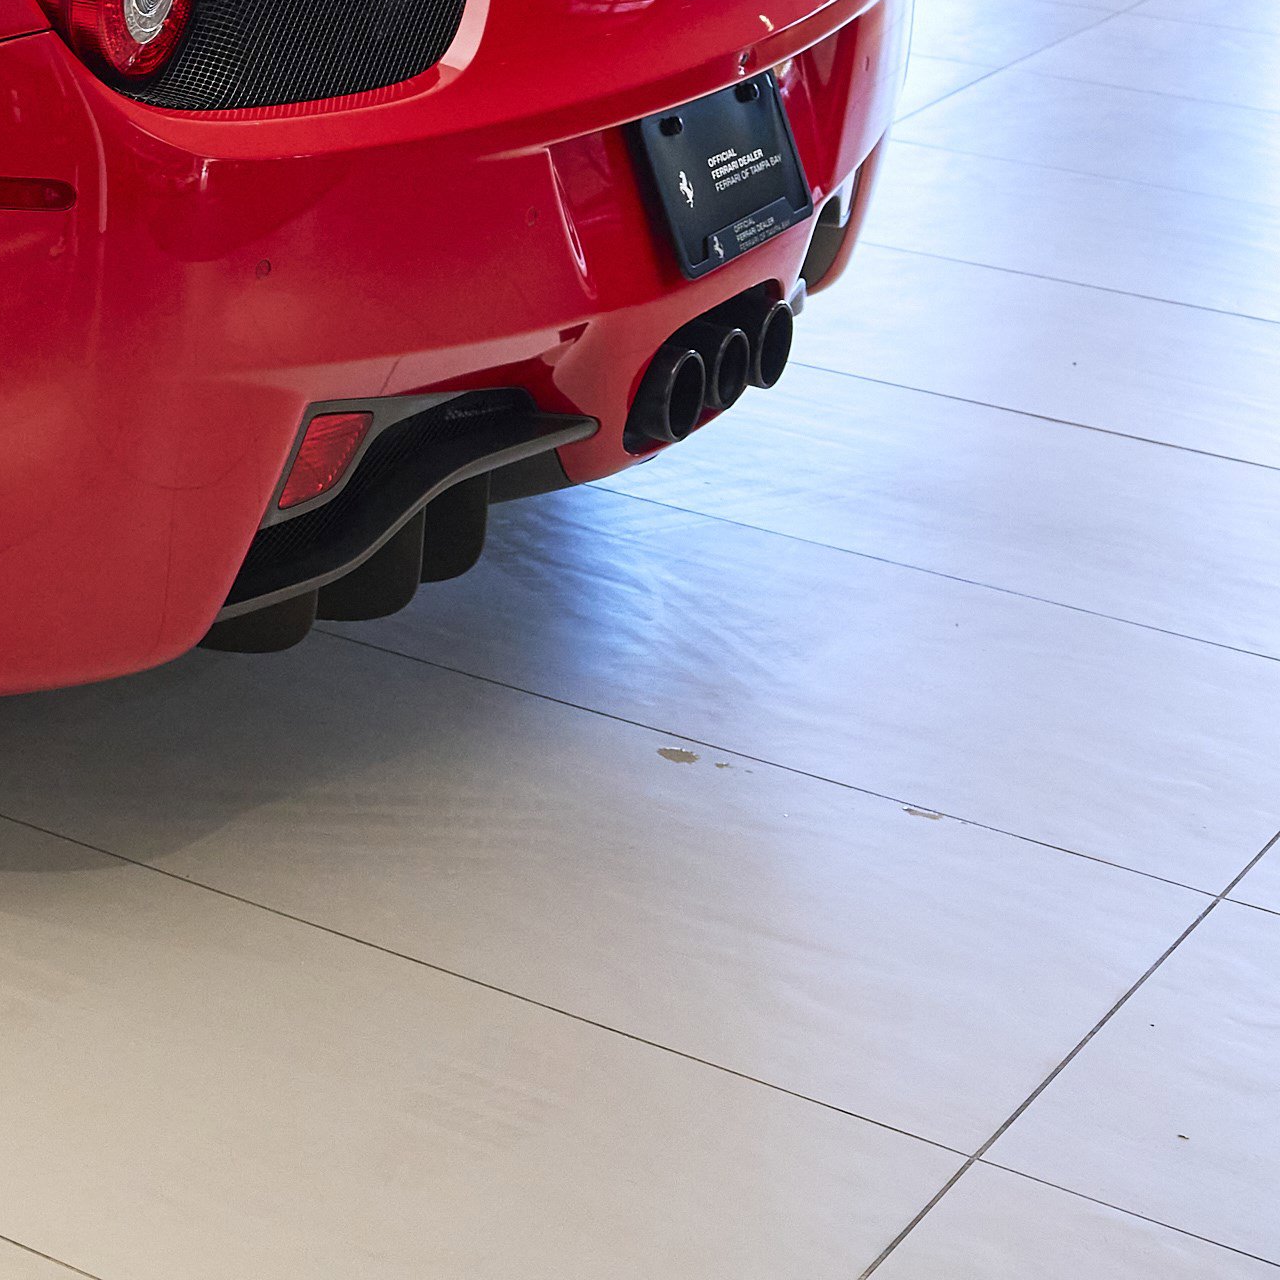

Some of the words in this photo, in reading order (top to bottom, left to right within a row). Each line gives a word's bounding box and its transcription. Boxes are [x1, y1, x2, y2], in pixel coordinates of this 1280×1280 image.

[707, 148, 737, 168] OFFICIAL
[711, 160, 739, 180] FERRARI
[737, 148, 764, 168] DEALER
[715, 172, 742, 192] FERRARI
[741, 167, 750, 180] OF
[749, 159, 771, 176] TAMPA
[769, 153, 782, 166] BAY
